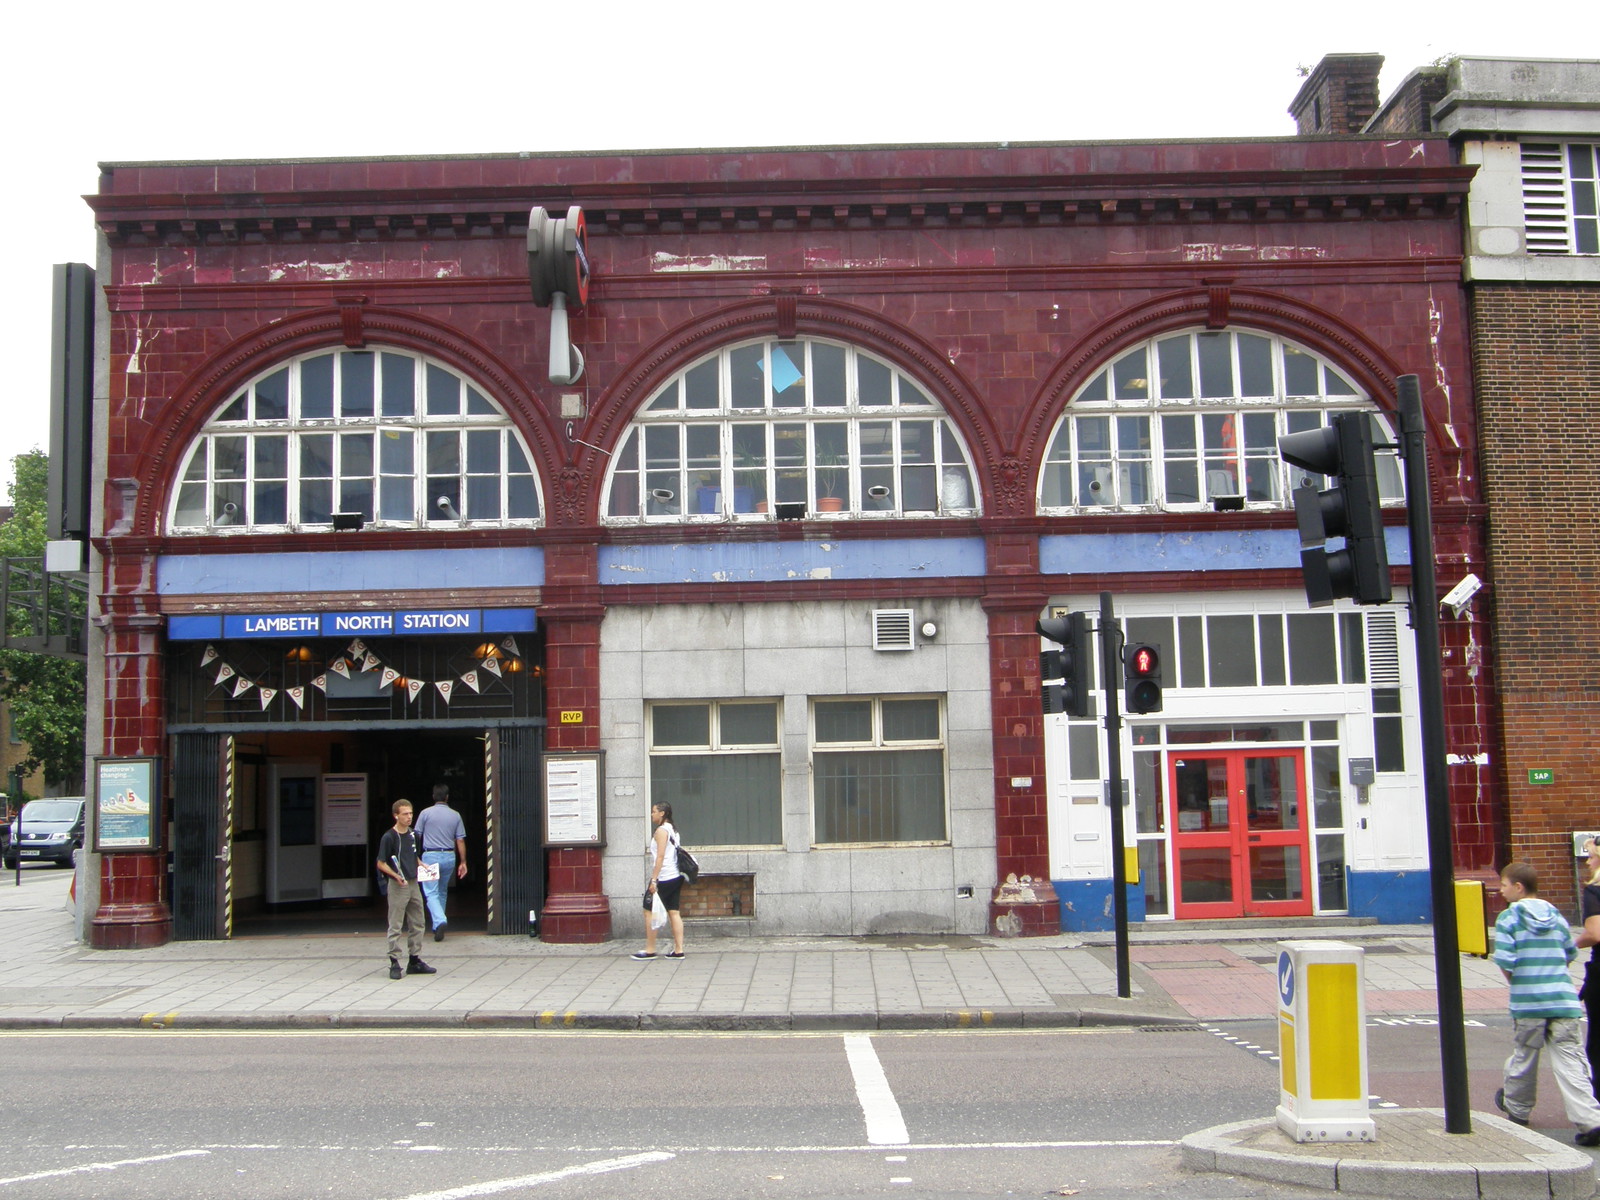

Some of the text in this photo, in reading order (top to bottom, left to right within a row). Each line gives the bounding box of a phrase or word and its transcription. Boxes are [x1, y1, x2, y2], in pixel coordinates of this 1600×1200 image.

[245, 613, 470, 632] LAMBETH NORTH STATION
[563, 713, 581, 721] RVP
[128, 792, 135, 802] 5
